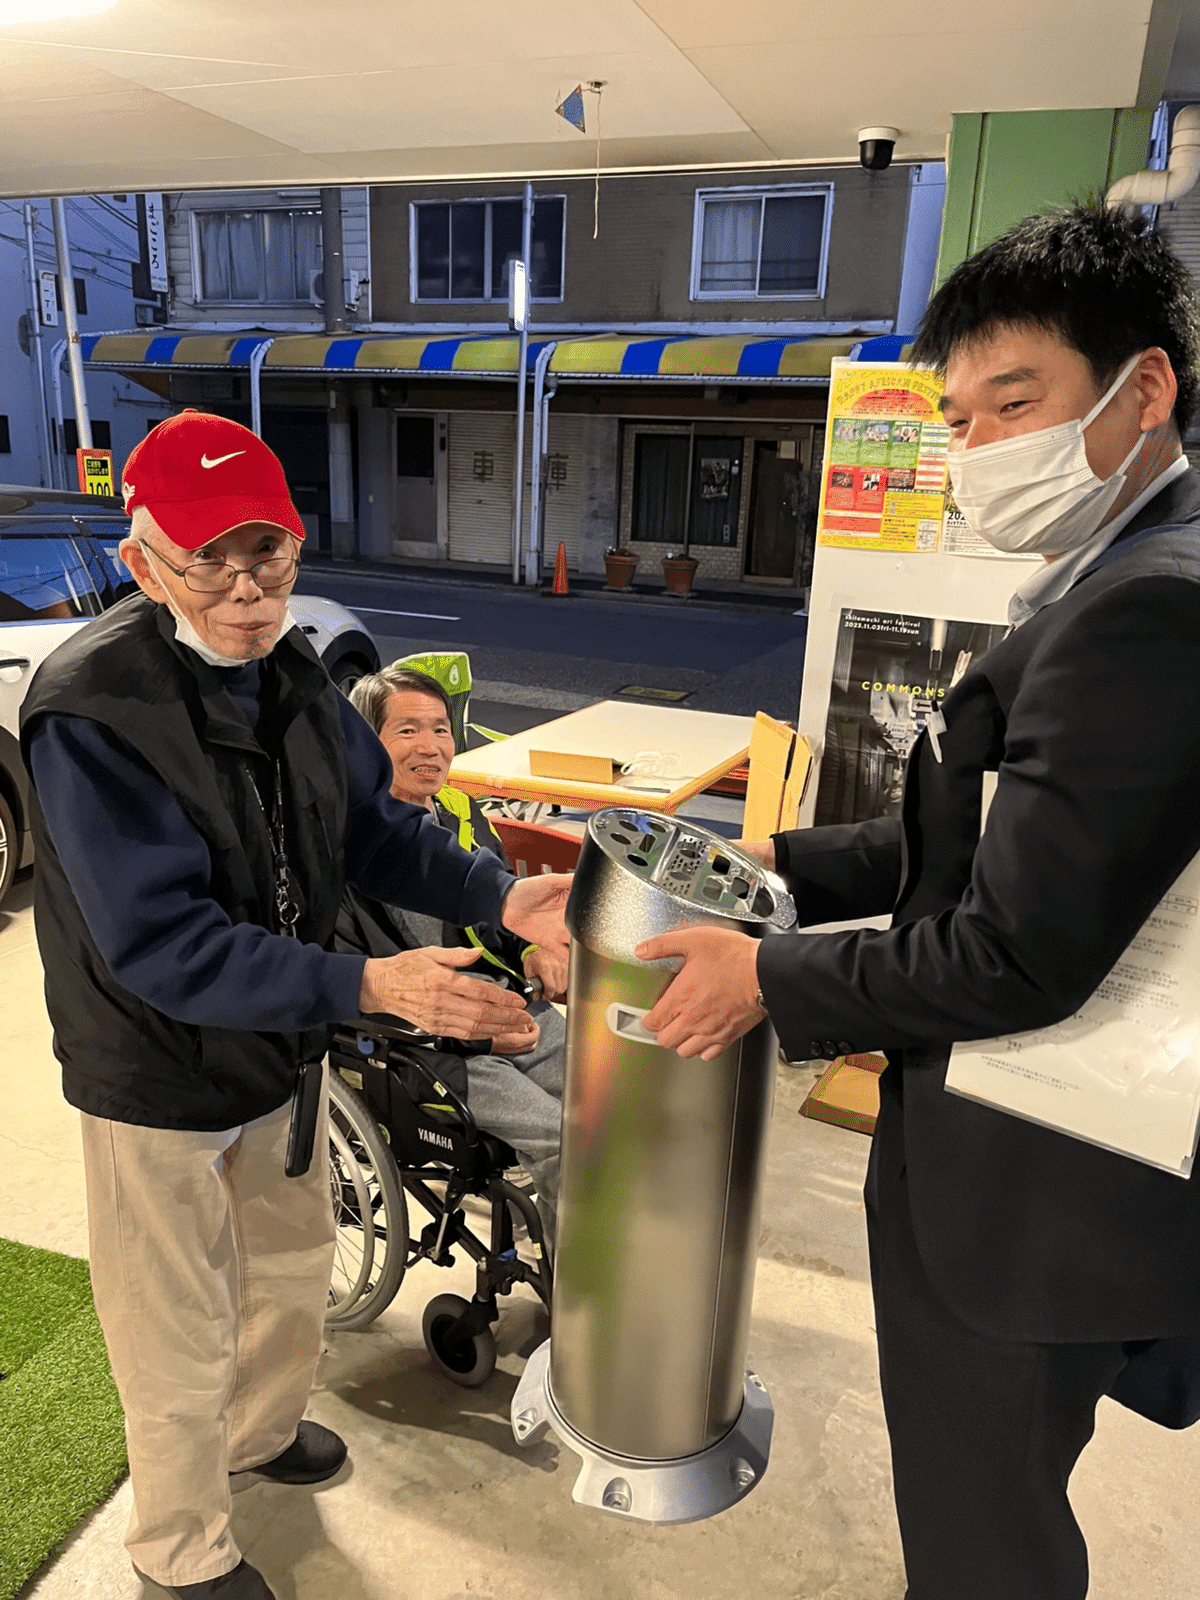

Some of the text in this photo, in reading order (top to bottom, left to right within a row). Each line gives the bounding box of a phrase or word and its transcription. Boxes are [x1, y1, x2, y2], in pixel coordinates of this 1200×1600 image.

[869, 376, 912, 388] AFRICAN
[473, 450, 494, 483] 車
[894, 618, 921, 628] festival
[861, 680, 946, 698] COMMONS
[417, 1127, 454, 1151] YAMAHA
